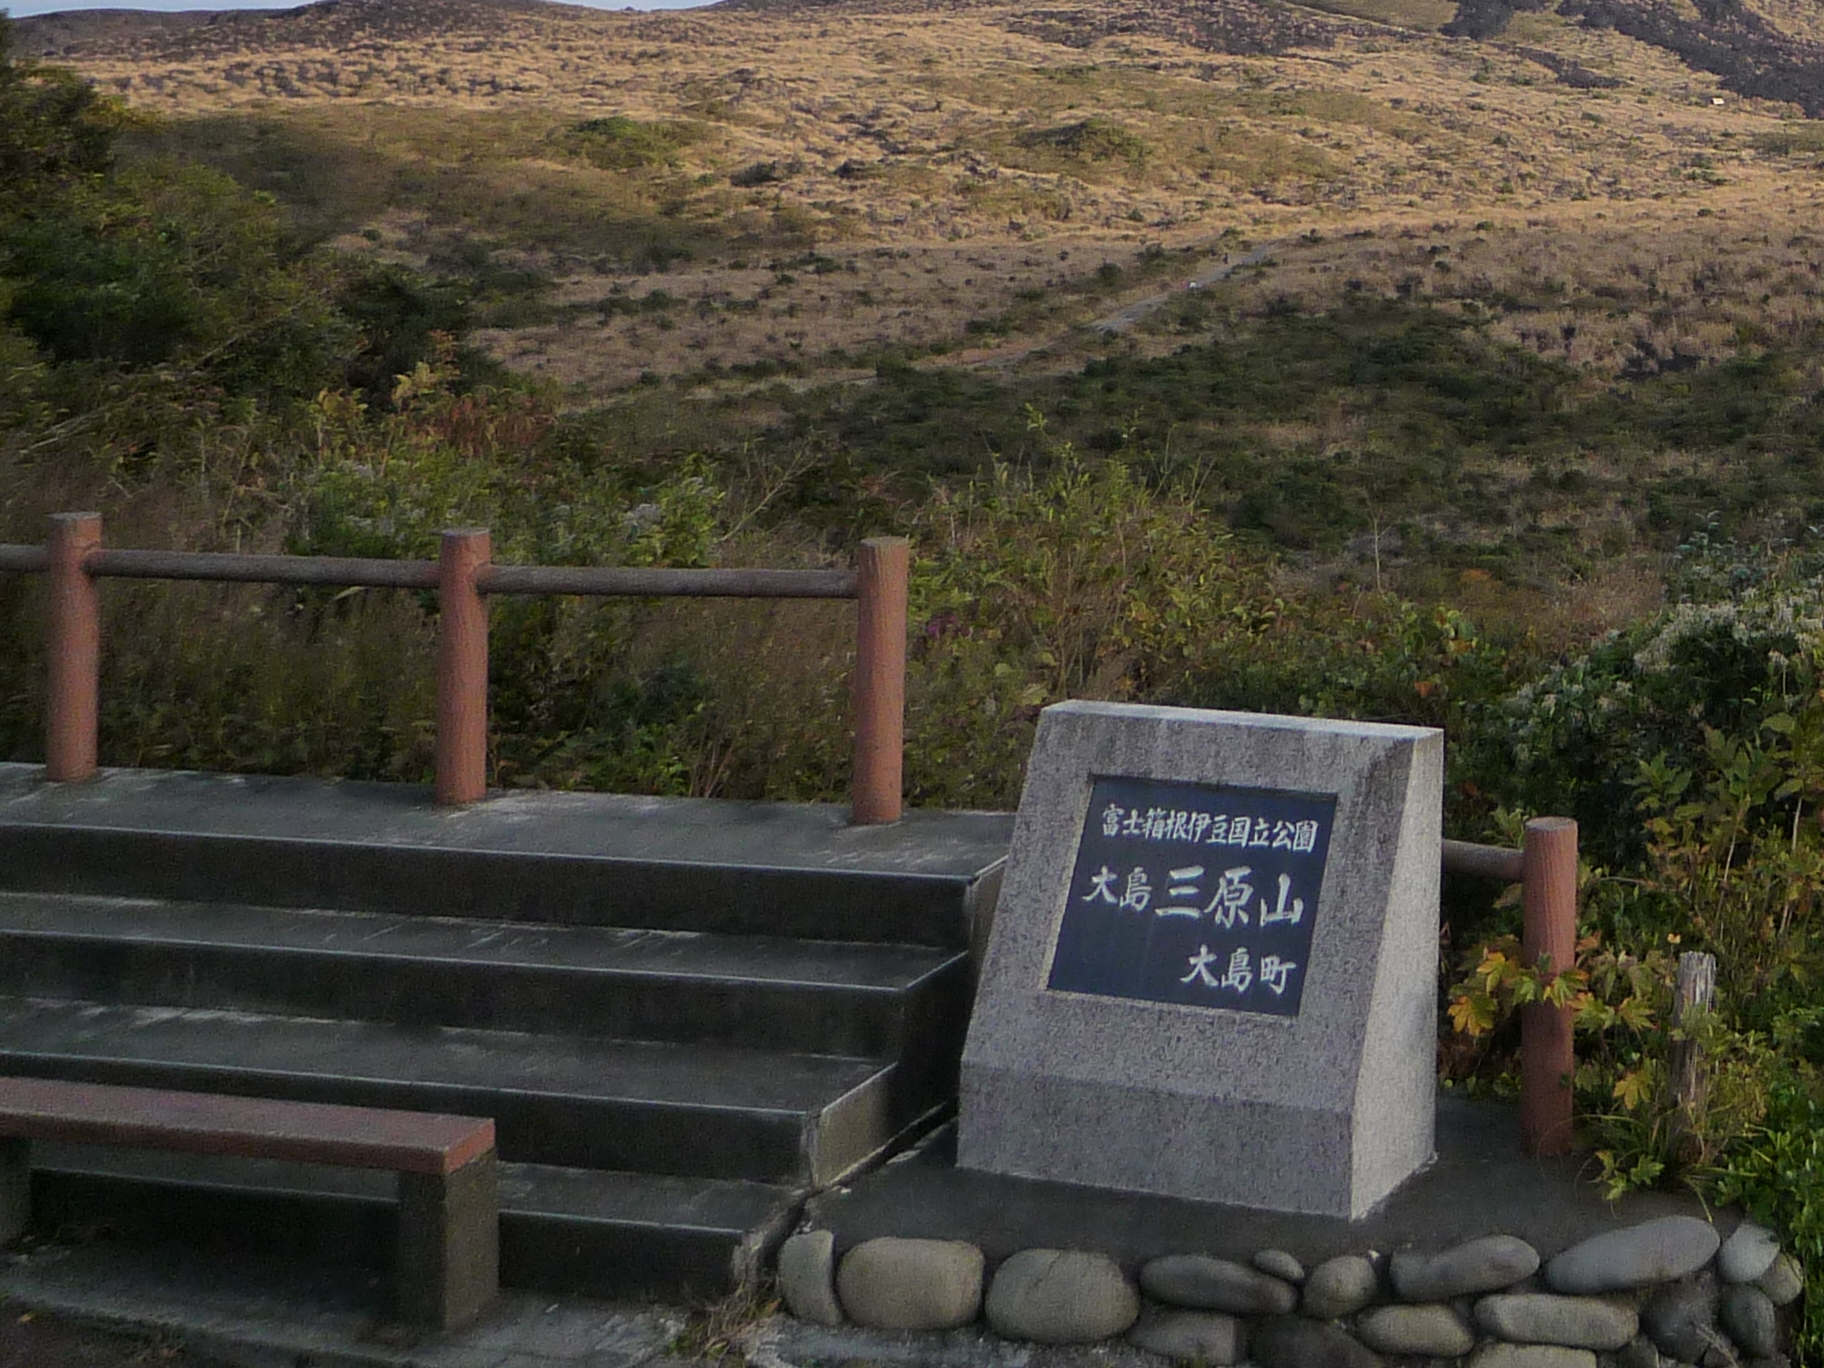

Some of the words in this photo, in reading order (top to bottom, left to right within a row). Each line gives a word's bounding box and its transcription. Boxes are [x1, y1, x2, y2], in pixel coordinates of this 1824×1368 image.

[1102, 803, 1318, 853] 富士箱根伊豆国立公園
[1180, 944, 1297, 995] 大島町
